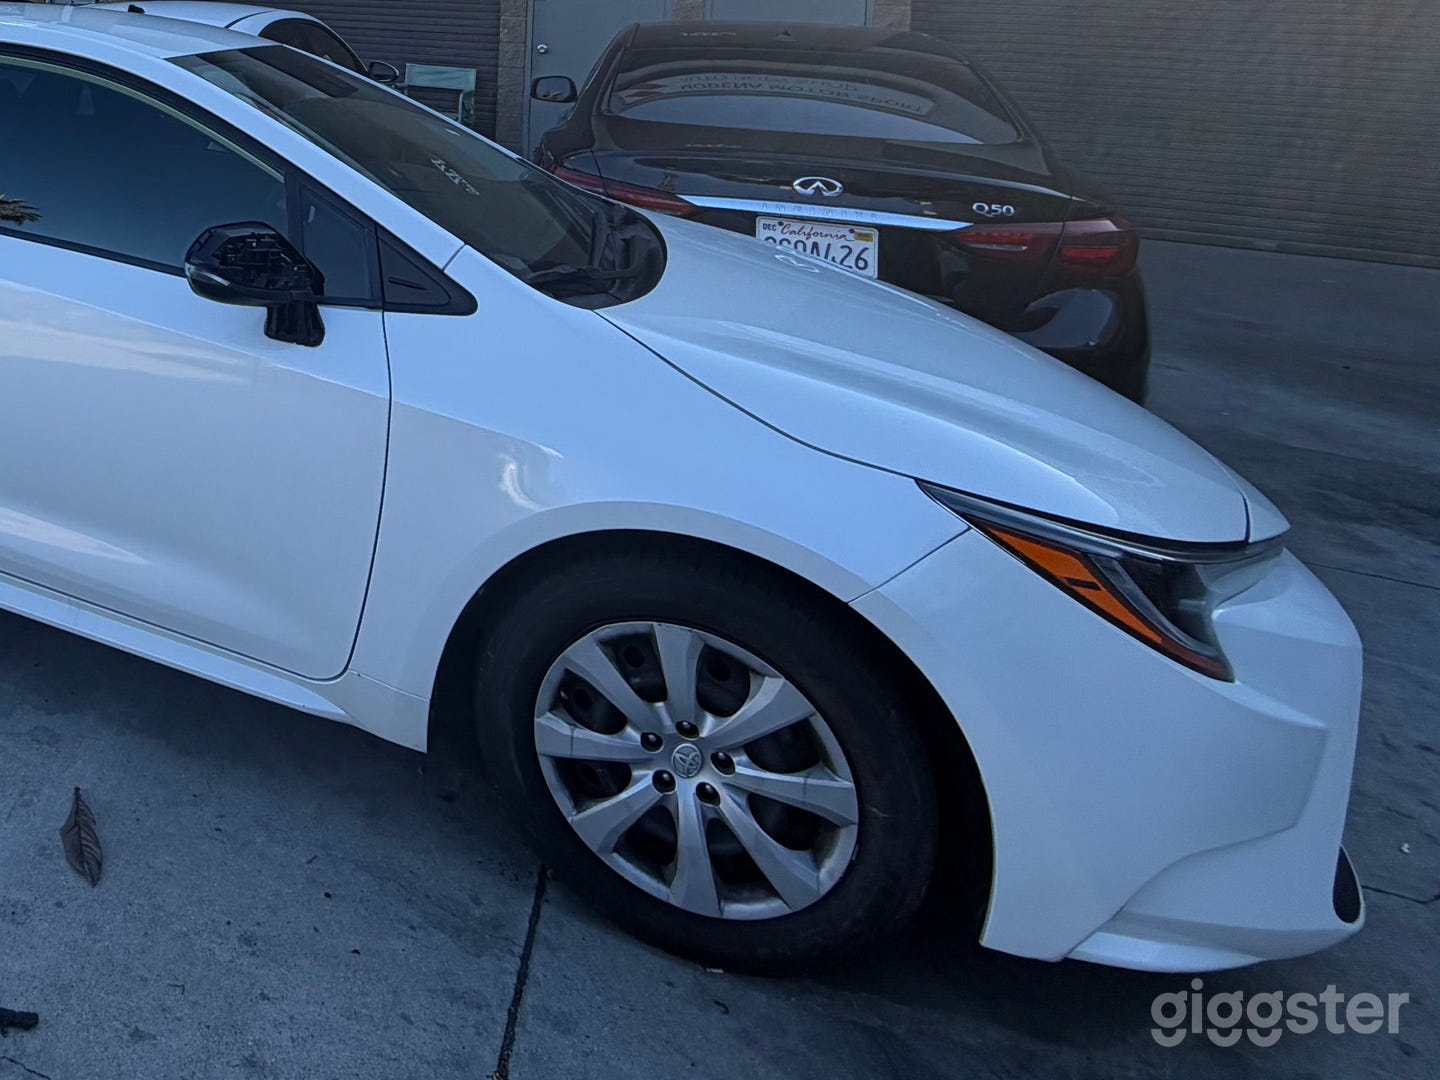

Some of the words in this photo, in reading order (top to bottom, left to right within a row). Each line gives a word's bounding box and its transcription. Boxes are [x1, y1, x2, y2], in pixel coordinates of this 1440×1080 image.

[972, 202, 1015, 217] Q50
[762, 222, 777, 232] DEC
[780, 223, 855, 242] California
